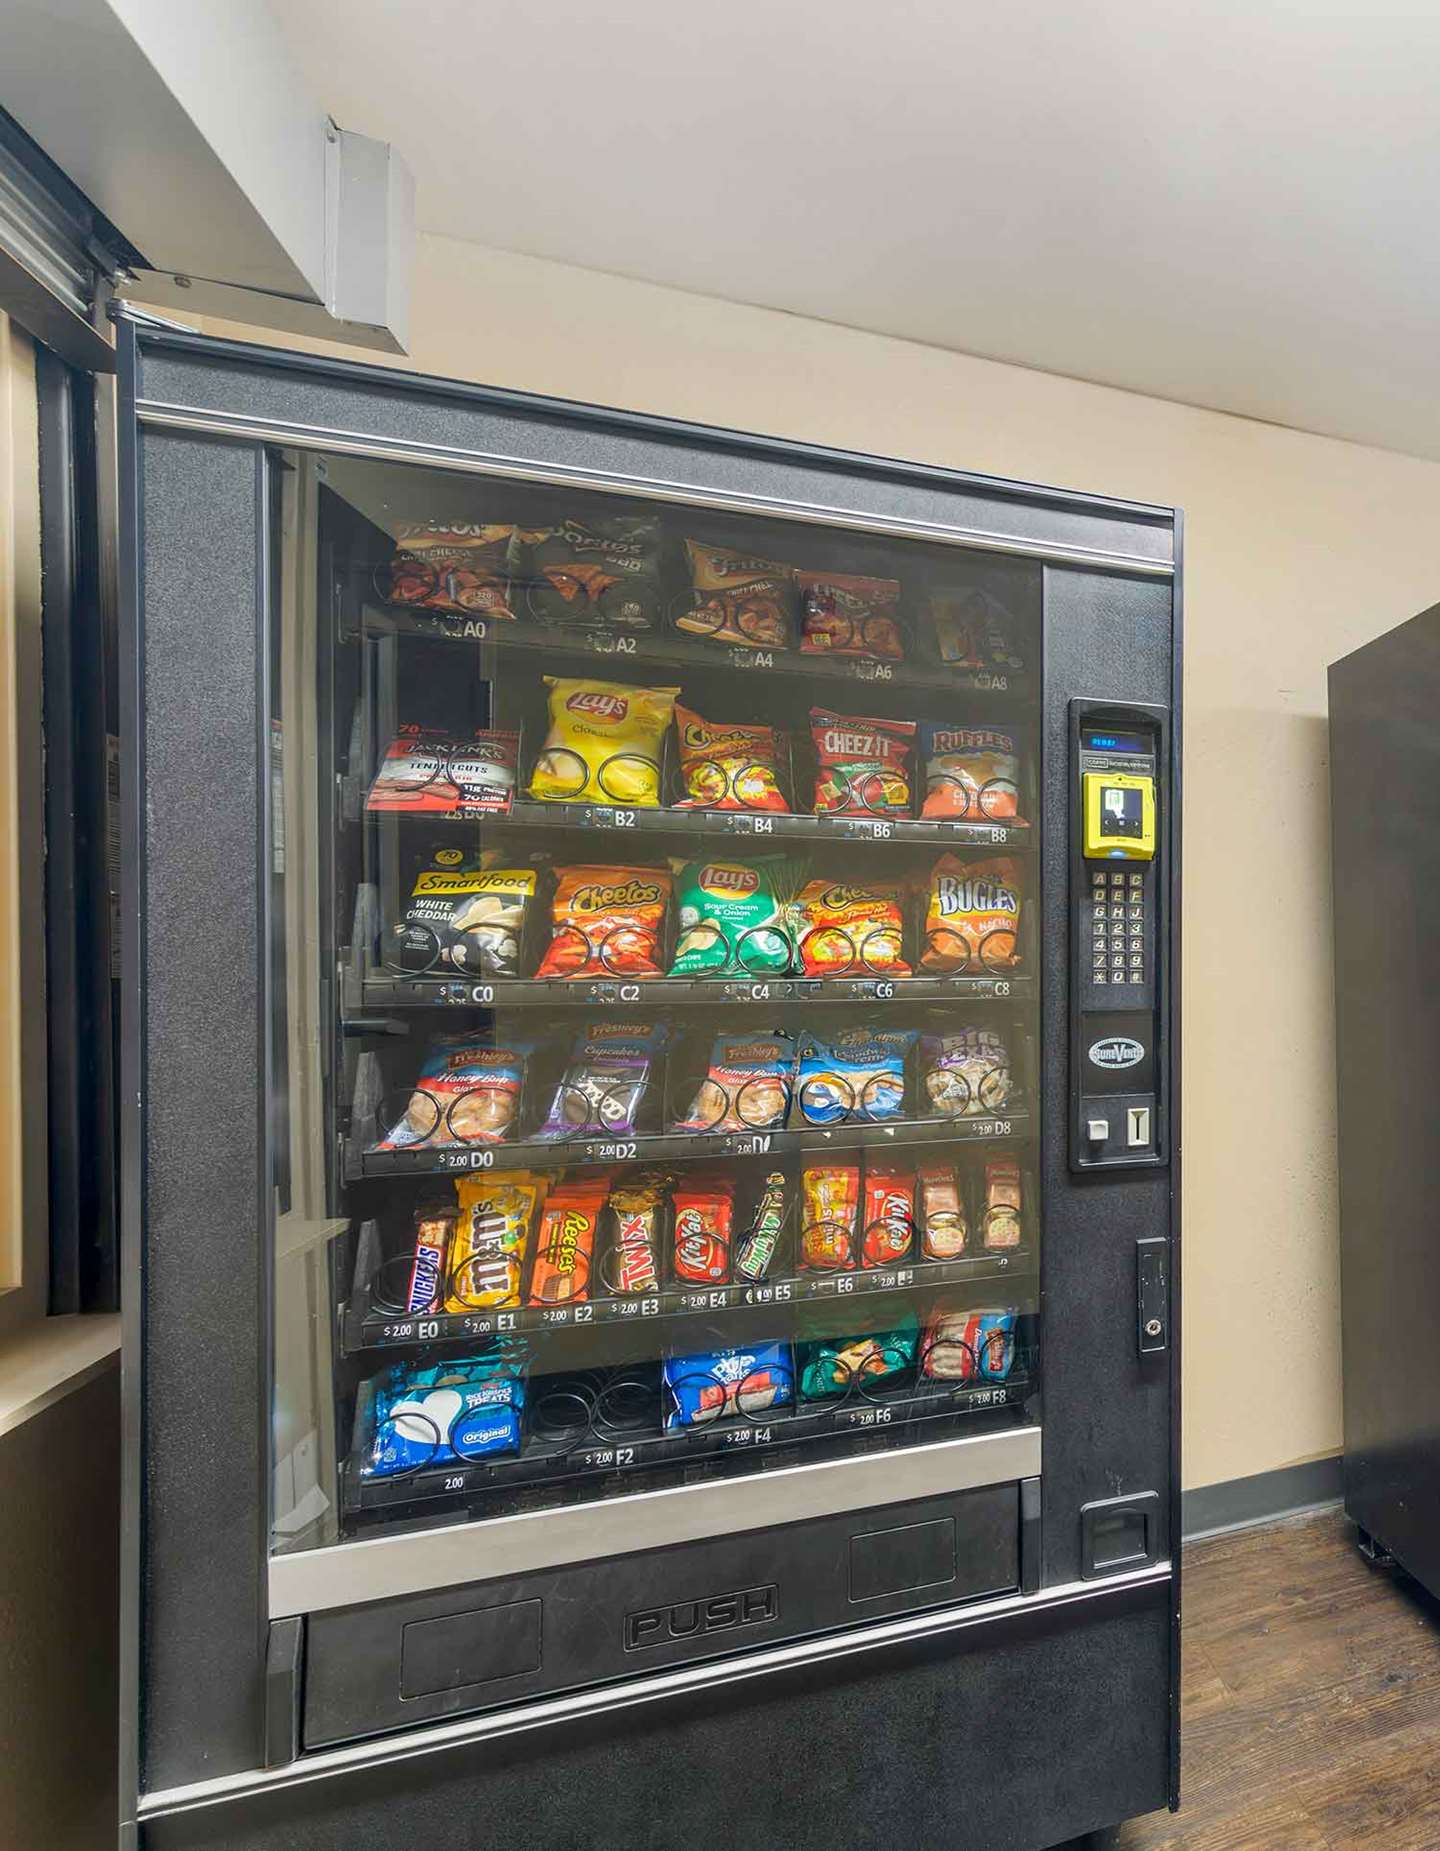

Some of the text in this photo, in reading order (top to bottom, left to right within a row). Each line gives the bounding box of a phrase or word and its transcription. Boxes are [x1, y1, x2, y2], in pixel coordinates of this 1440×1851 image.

[464, 622, 486, 638] A0
[617, 638, 636, 654] A2
[755, 652, 773, 667] A4
[875, 665, 893, 680] A6
[932, 731, 1013, 752] RUFFLES
[615, 811, 635, 827] B2
[754, 818, 773, 833] B4
[873, 824, 891, 839] B6
[991, 829, 1007, 843] B8
[420, 872, 531, 892] Smartfood
[705, 868, 757, 891] Lay's
[571, 881, 661, 912] Cheetos
[938, 876, 1017, 916] BUGLES
[1132, 892, 1141, 902] F
[415, 899, 453, 911] WHITE
[704, 903, 759, 912] Sour Cream
[1095, 907, 1140, 917] G H J
[406, 910, 456, 922] CHEDDAR
[724, 909, 751, 917] Onion
[1097, 924, 1140, 933] 1 2 3
[1095, 939, 1140, 949] 4 5 6
[1096, 956, 1140, 966] 7 8 9
[471, 986, 494, 1002] C0
[620, 986, 640, 1001] C2
[752, 985, 770, 999] C4
[876, 984, 893, 998] C6
[995, 982, 1010, 996] C8
[995, 1122, 1011, 1134] D8
[616, 1143, 637, 1159] D2
[450, 1155, 467, 1167] 2.00
[470, 1151, 494, 1168] D0
[558, 1210, 591, 1275] Reese's
[838, 1278, 853, 1293] E6
[881, 1276, 895, 1287] 2.00
[690, 1296, 707, 1307] 2.00
[710, 1293, 727, 1308] E4
[775, 1286, 791, 1300] E5
[549, 1310, 567, 1321] 2.00
[575, 1306, 593, 1322] E2
[621, 1303, 638, 1314] 2.00
[642, 1299, 659, 1315] E3
[392, 1325, 412, 1337] 2.00
[418, 1322, 438, 1339] E0
[473, 1321, 491, 1333] 2.00
[497, 1313, 517, 1330] E1
[978, 1393, 991, 1404] 2.00
[993, 1390, 1007, 1404] F8
[860, 1415, 874, 1425] 2.00
[875, 1408, 892, 1422] F6
[464, 1426, 509, 1442] Original
[735, 1430, 750, 1442] 2.00
[755, 1428, 771, 1443] F4
[596, 1452, 613, 1464] 2.00
[616, 1449, 634, 1465] F2
[445, 1477, 463, 1490] 2.00
[630, 1589, 774, 1647] PUSH
